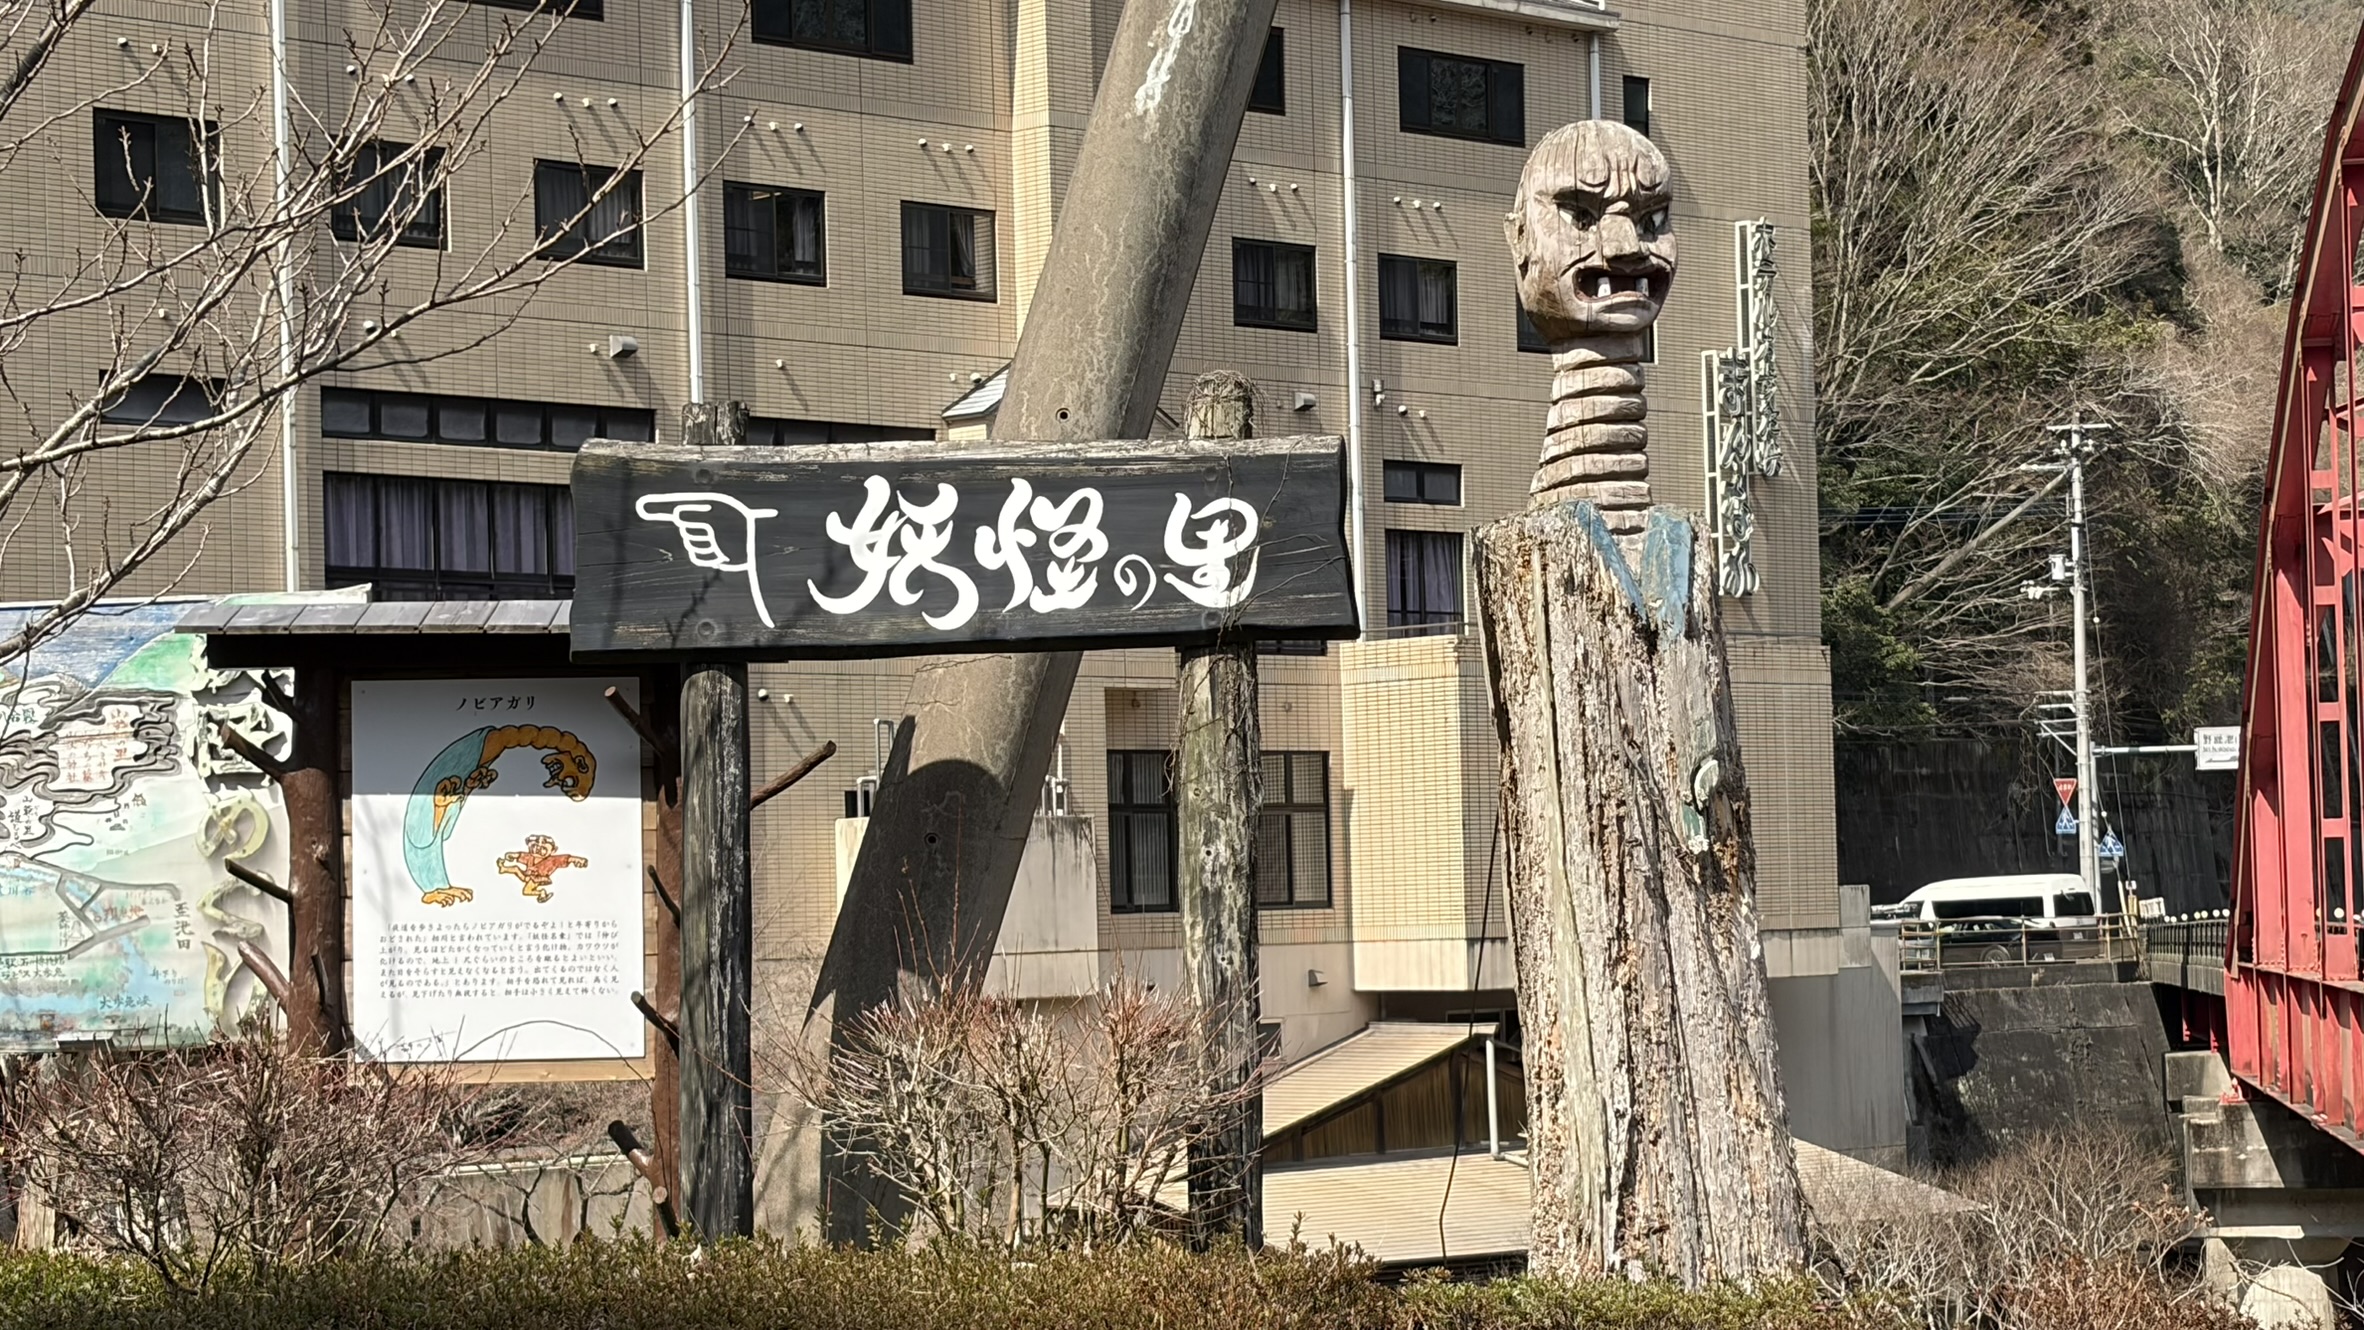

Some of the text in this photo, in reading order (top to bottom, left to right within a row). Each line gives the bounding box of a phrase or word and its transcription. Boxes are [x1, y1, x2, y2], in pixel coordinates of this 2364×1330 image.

[807, 475, 1259, 631] 妖怪の里
[456, 695, 537, 711] ノビアガリ
[173, 902, 195, 950] 至池田
[99, 994, 152, 1010] 大歩危峡
